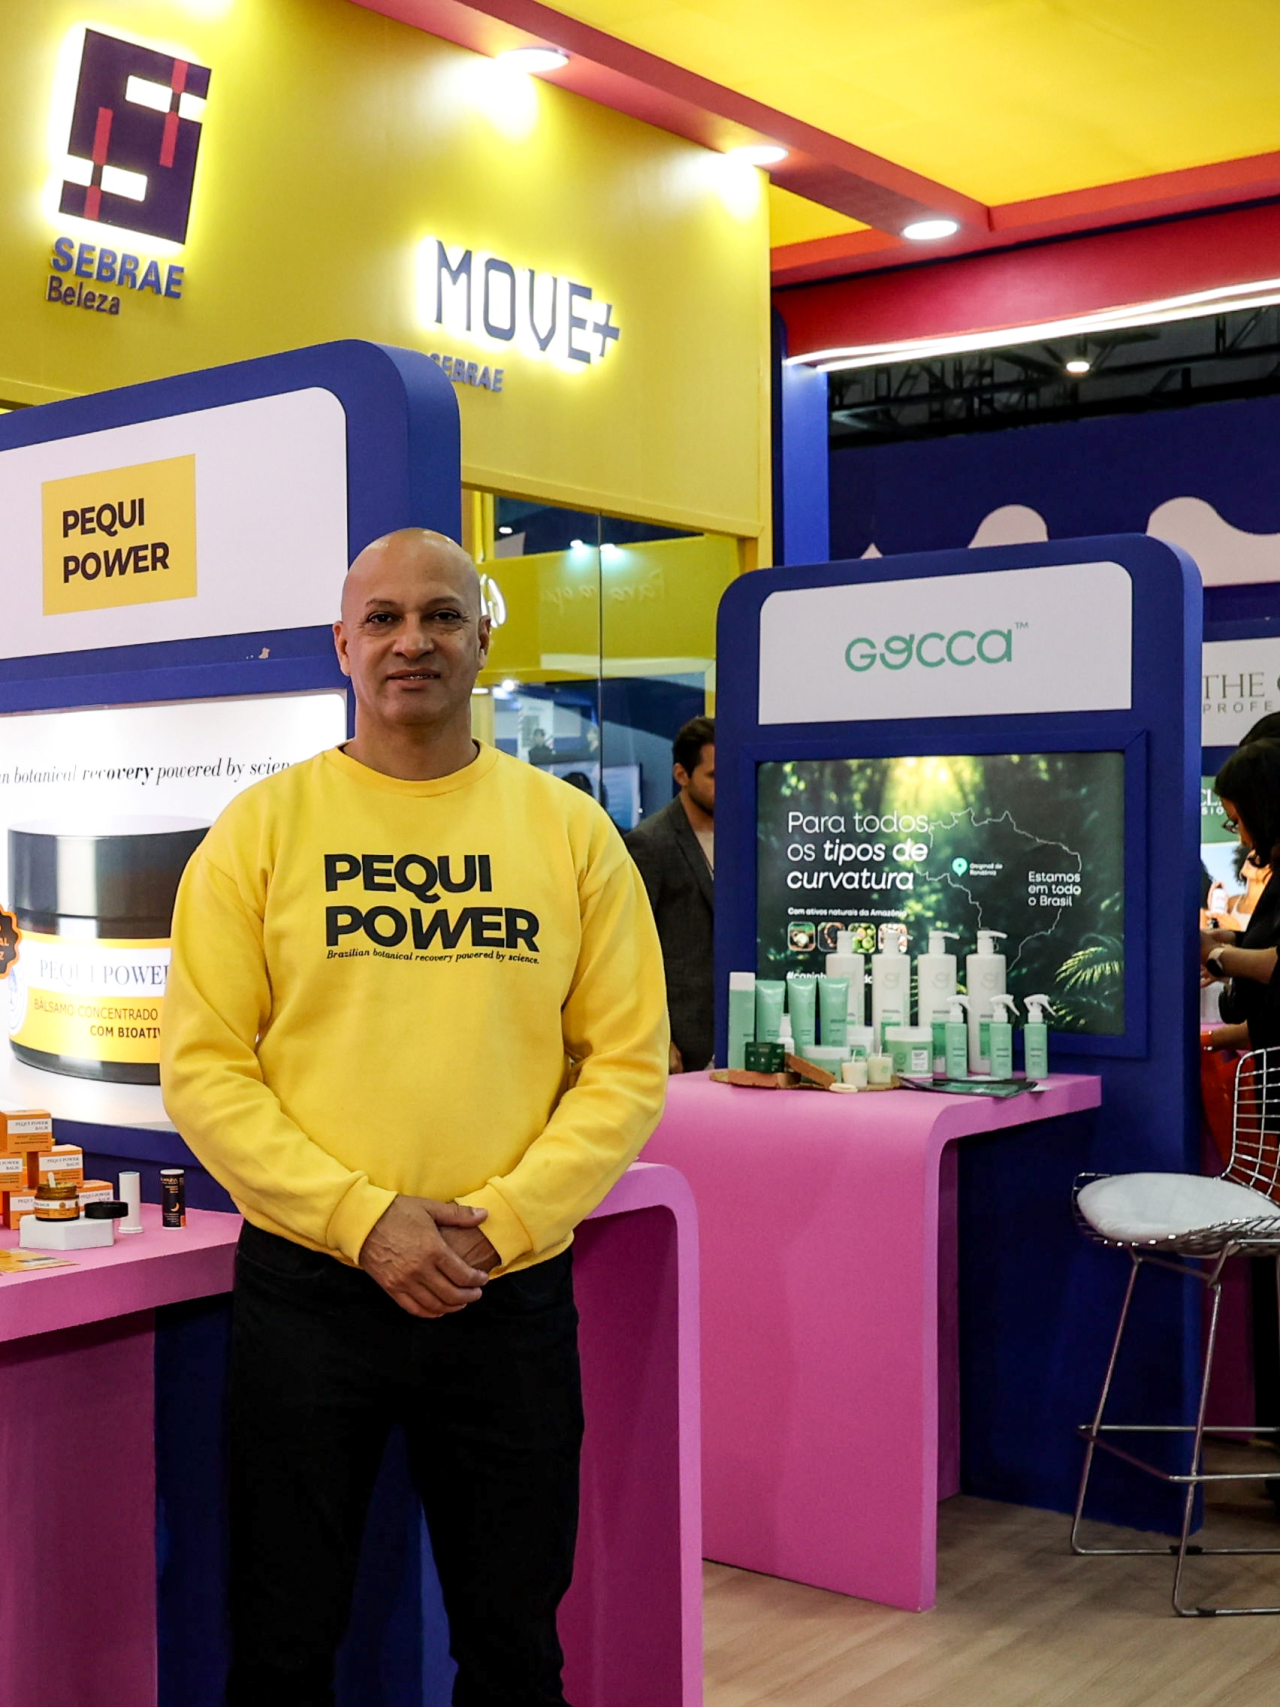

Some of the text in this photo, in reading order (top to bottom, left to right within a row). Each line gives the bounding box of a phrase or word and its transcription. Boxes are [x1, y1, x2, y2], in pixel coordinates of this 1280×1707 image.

[51, 237, 185, 299] SEBRAE
[46, 275, 120, 315] Beleza
[63, 498, 144, 538] PEQUI
[63, 542, 170, 583] POWER
[1202, 672, 1265, 700] THE
[14, 764, 77, 784] botanical
[83, 766, 154, 786] recovery
[156, 757, 222, 786] powered
[226, 757, 245, 782] by
[788, 810, 928, 833] Para todos
[787, 837, 928, 866] os tipos de
[324, 853, 492, 903] PEQUI
[786, 868, 914, 890] curvatura
[1028, 871, 1081, 882] Estamos
[1028, 884, 1081, 895] em todo
[788, 907, 805, 915] Com
[806, 907, 827, 915] ativos
[828, 908, 858, 916] naturais
[1028, 895, 1072, 906] o Brasil
[325, 905, 540, 952] POWER
[326, 948, 540, 964] Brazilian botanical recovery powered by science.
[34, 996, 158, 1021] BÁLSAMO CONCENTRADO
[90, 1025, 114, 1037] COM
